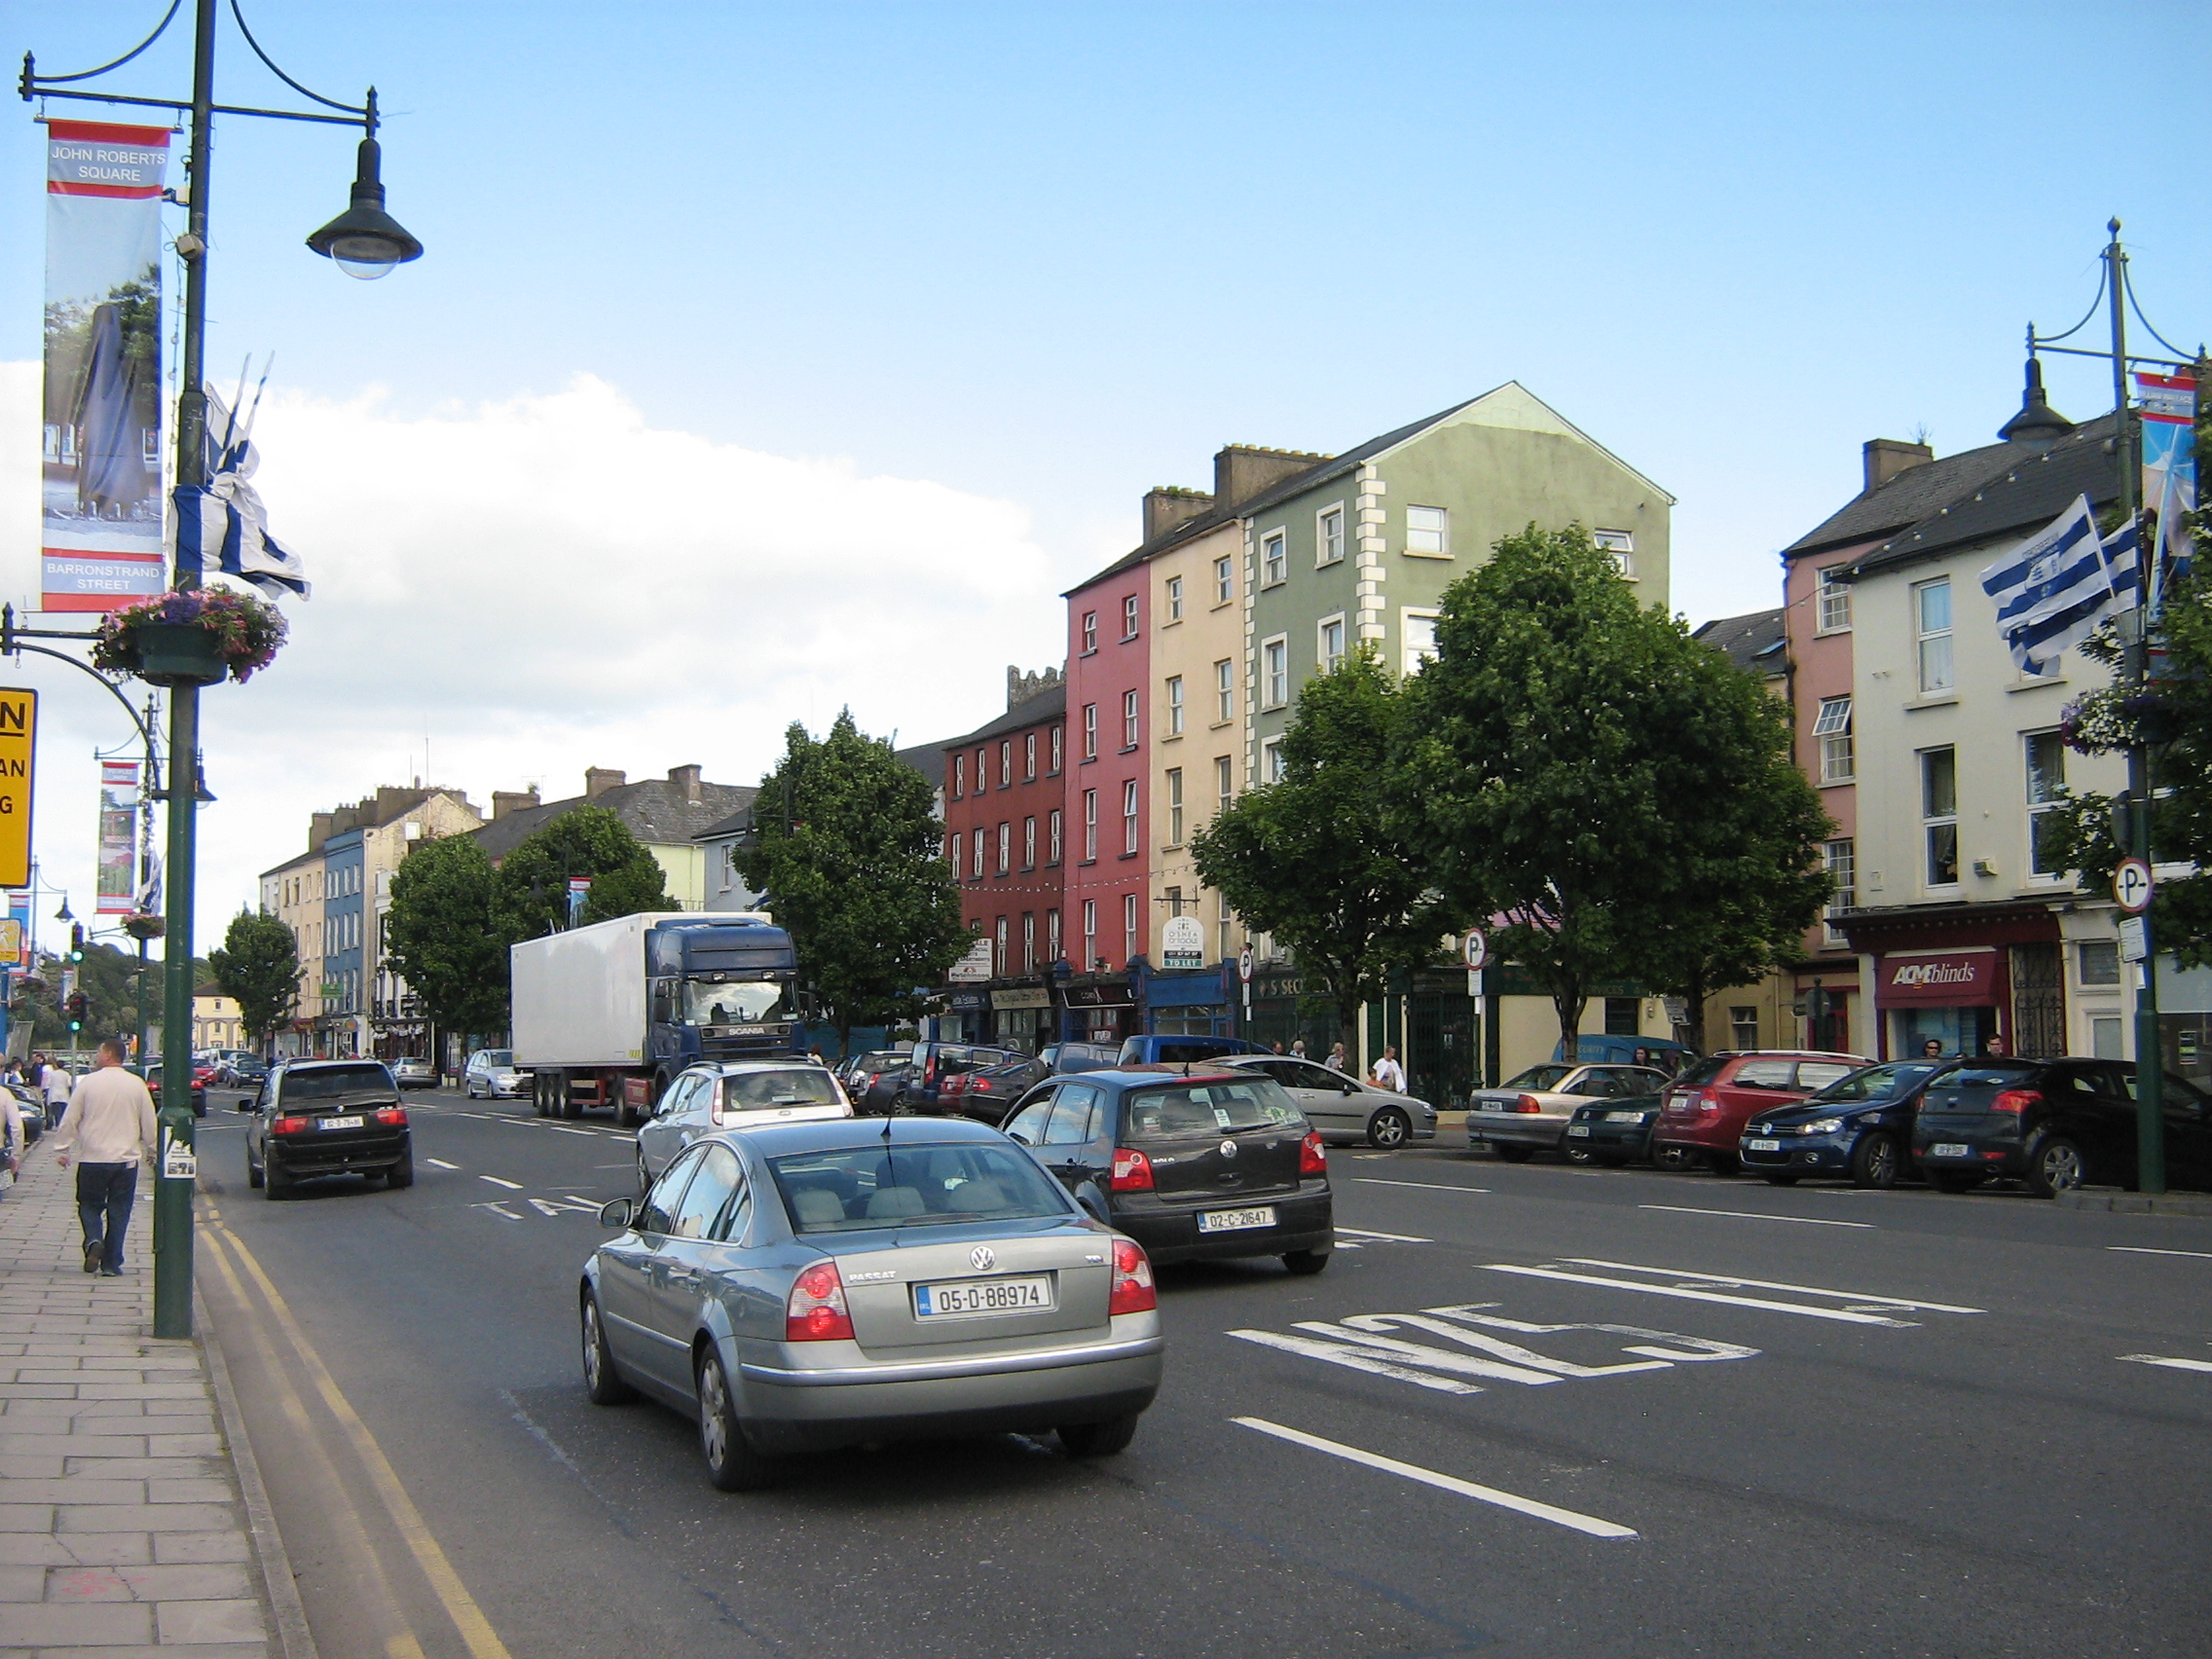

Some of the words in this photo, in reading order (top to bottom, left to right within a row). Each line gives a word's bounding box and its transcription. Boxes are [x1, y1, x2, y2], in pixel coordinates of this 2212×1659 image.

[52, 147, 92, 162] JOHN
[97, 150, 166, 166] ROBERTS
[78, 166, 141, 182] SQUARE
[47, 562, 160, 578] BARRONSTRAND
[77, 578, 130, 590] STREET
[2125, 867, 2138, 903] P
[1470, 937, 1479, 964] P
[728, 1027, 765, 1036] SCANIA
[1209, 1210, 1267, 1228] 02-C-21647
[848, 1270, 898, 1282] PASSAT
[939, 1284, 1040, 1311] 05-D-88974
